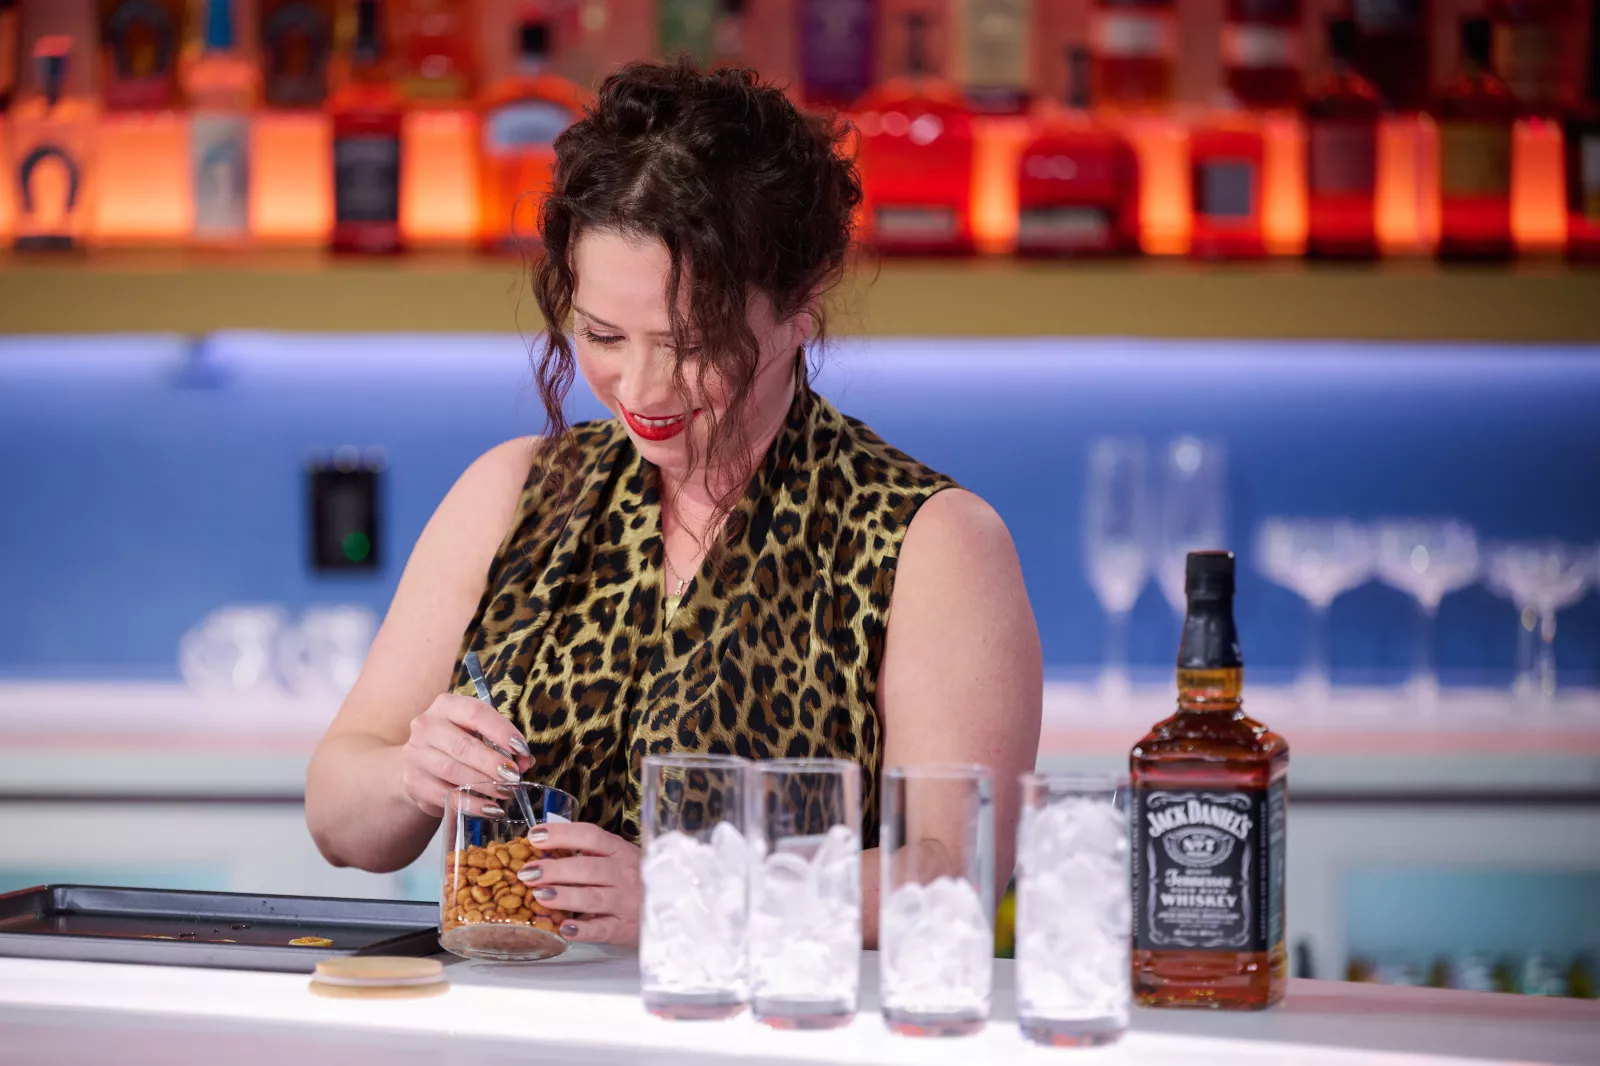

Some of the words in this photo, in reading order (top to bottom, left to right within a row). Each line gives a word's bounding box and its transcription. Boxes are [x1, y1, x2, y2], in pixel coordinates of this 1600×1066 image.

[1146, 804, 1188, 837] JACK
[1187, 799, 1253, 839] DANIEL'S
[1160, 893, 1239, 908] WHISKEY
